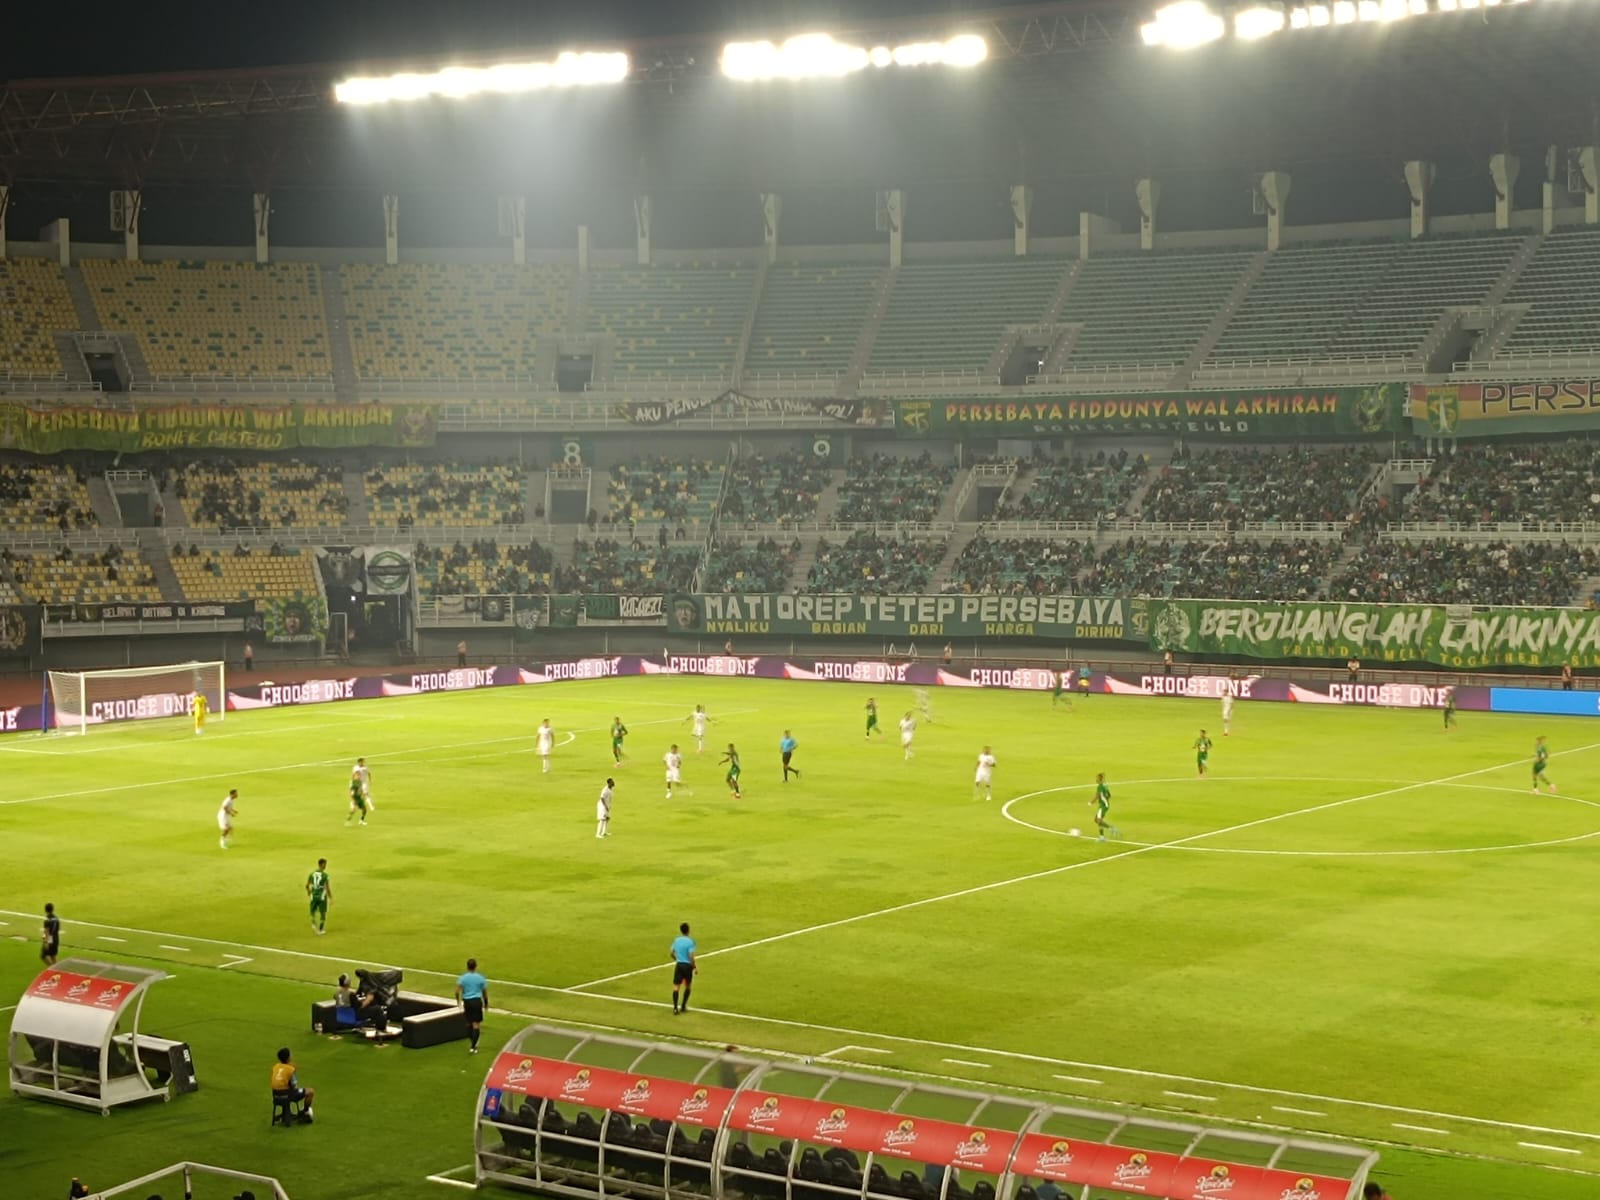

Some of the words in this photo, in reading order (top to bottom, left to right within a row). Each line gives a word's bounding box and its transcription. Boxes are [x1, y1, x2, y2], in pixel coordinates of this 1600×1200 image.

[253, 405, 296, 430] WAL
[945, 402, 1063, 422] PERSEBAYA
[1068, 399, 1179, 420] FIDDUNYA
[1185, 397, 1229, 417] WAL
[1234, 393, 1339, 415] AKHIRAH
[564, 442, 581, 466] 8
[704, 596, 770, 620] MATI
[776, 597, 853, 621] OREP
[860, 597, 955, 622] TETEP
[961, 597, 1124, 625] PERSEBAYA
[706, 622, 770, 633] NYALIKU
[811, 622, 867, 634] BAGIAN
[909, 623, 944, 635] DARI
[985, 623, 1034, 636] HARGA
[1075, 626, 1124, 639] DIRIMU
[1199, 604, 1432, 650] BERJUANGLAH
[545, 662, 590, 679] CHOOSE
[595, 660, 618, 676] ONE
[670, 656, 723, 673] CHOOSE
[728, 658, 755, 675] ONE
[815, 662, 871, 680] CHOOSE
[876, 664, 906, 682] ONE
[411, 671, 463, 690] CHOOSE
[468, 668, 494, 686] ONE
[970, 668, 1032, 687] CHOOSE
[1141, 675, 1209, 694] CHOOSE
[1215, 679, 1251, 697] ONE
[261, 682, 319, 705] CHOOSE
[325, 680, 355, 700] ONE
[1329, 683, 1402, 705] CHOOSE
[1410, 687, 1448, 706] ONE
[92, 695, 158, 721] CHOOSE
